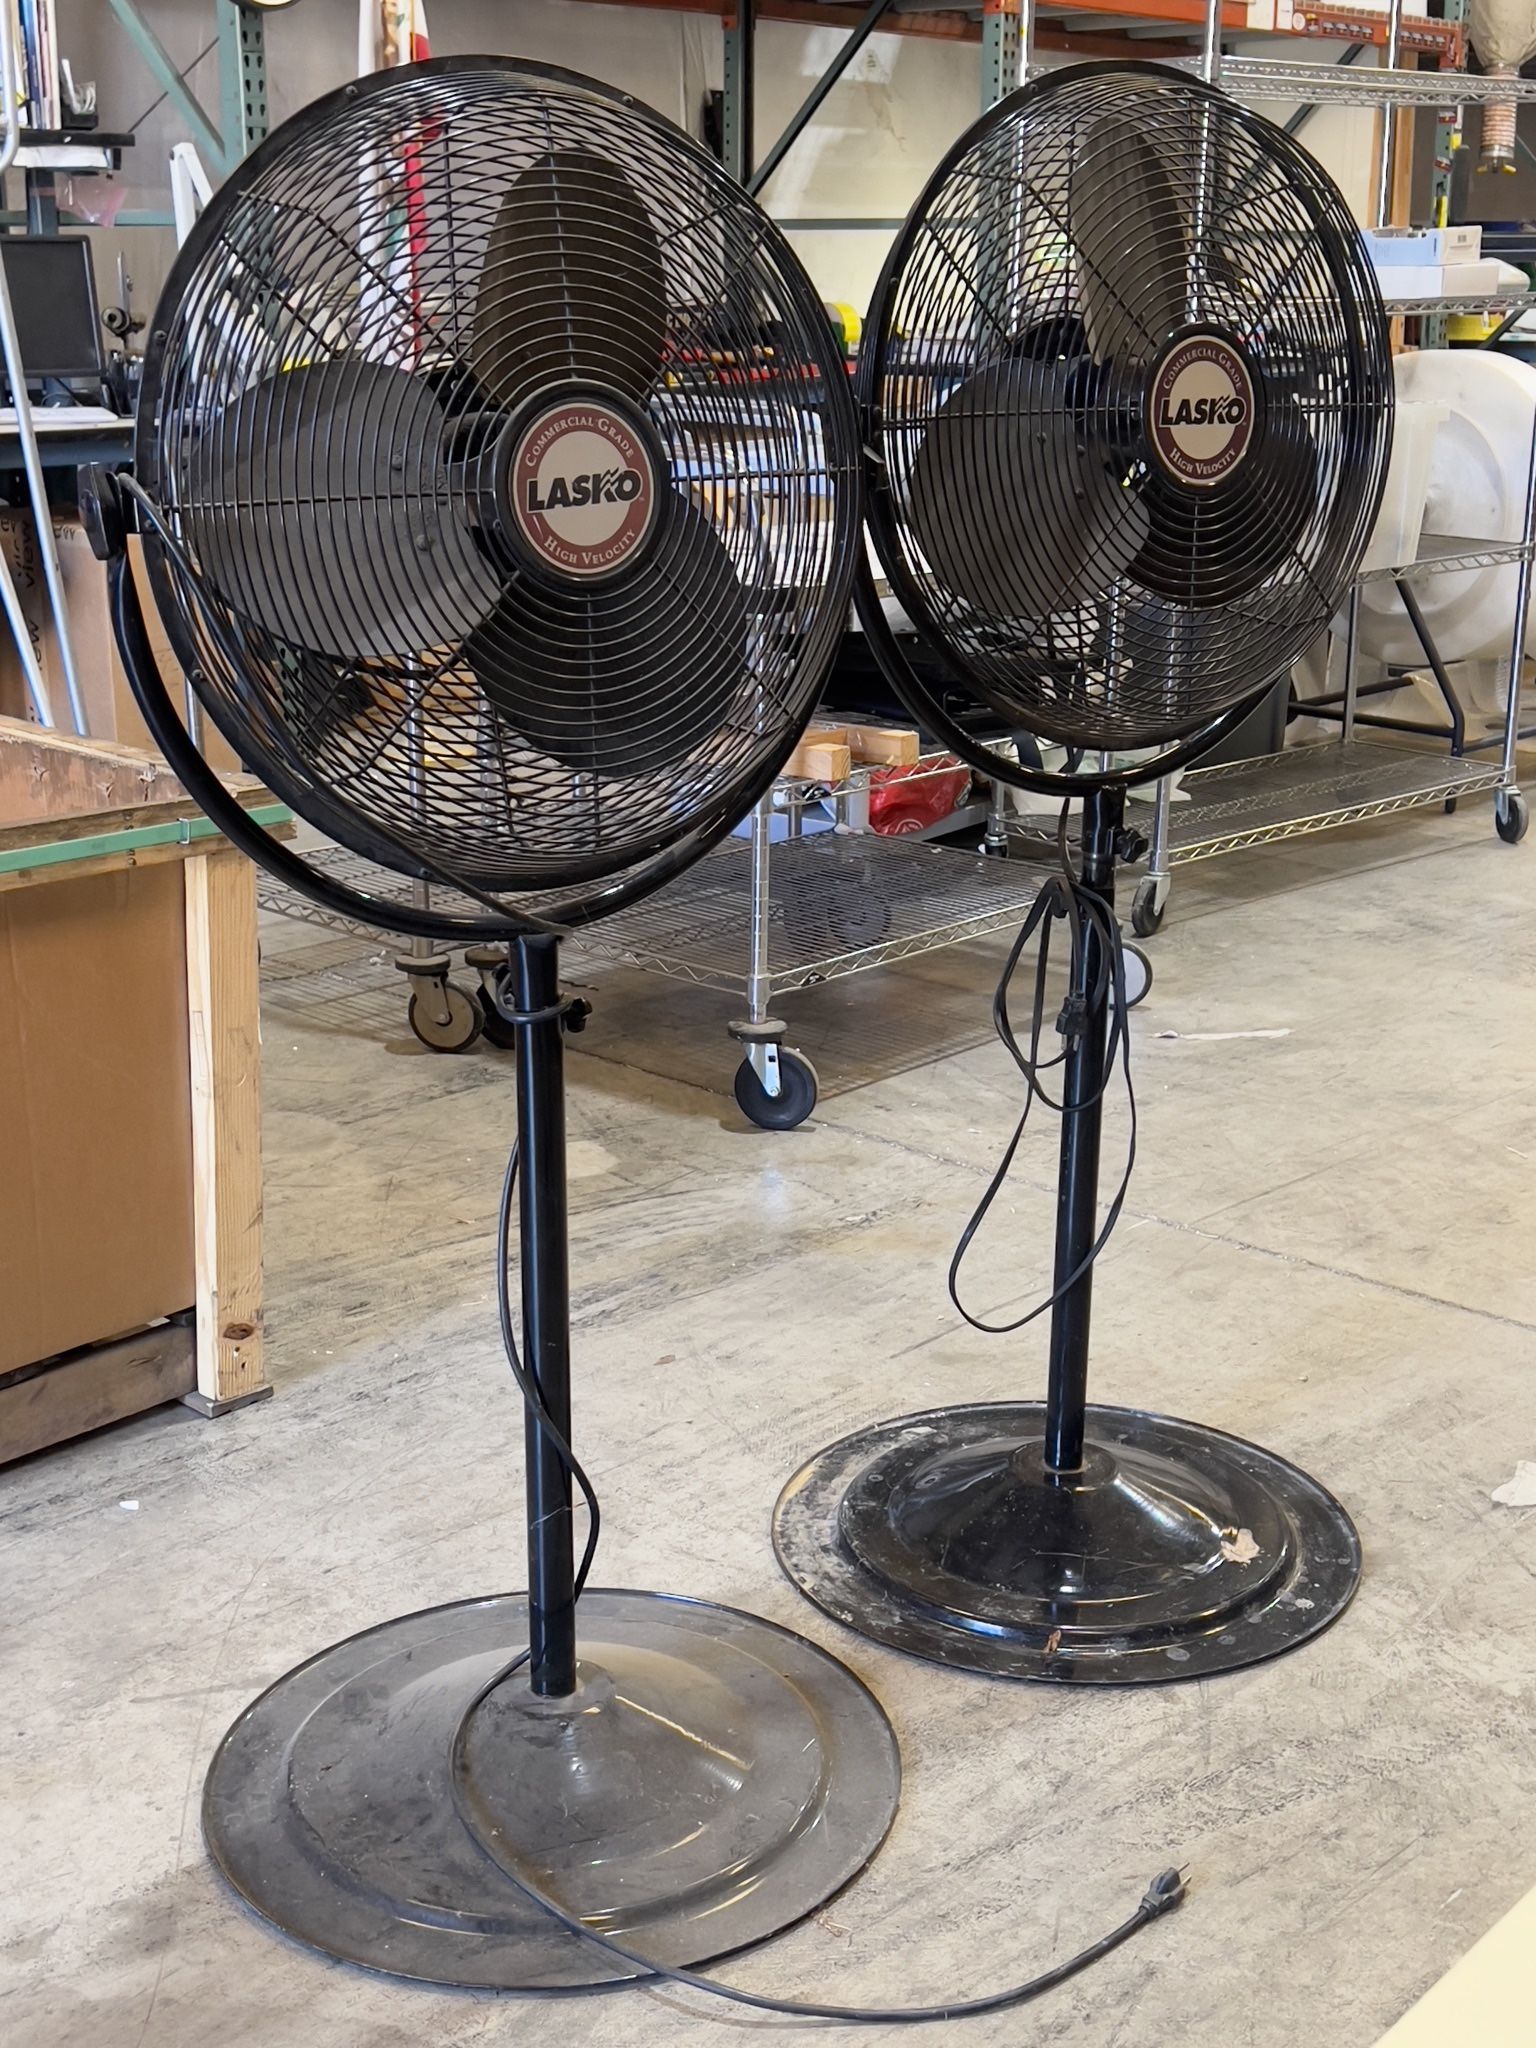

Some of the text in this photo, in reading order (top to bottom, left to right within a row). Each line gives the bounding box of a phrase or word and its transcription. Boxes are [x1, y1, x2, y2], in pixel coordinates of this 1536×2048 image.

[1163, 347, 1243, 390] COMMERCIAL GRADE
[1160, 394, 1246, 426] LASKO
[525, 416, 634, 467] COMMERCIAL GRADE
[1169, 447, 1236, 475] HIGH VELOCITY
[528, 467, 642, 512] LASKO
[543, 528, 635, 565] HIGH VELOCITY
